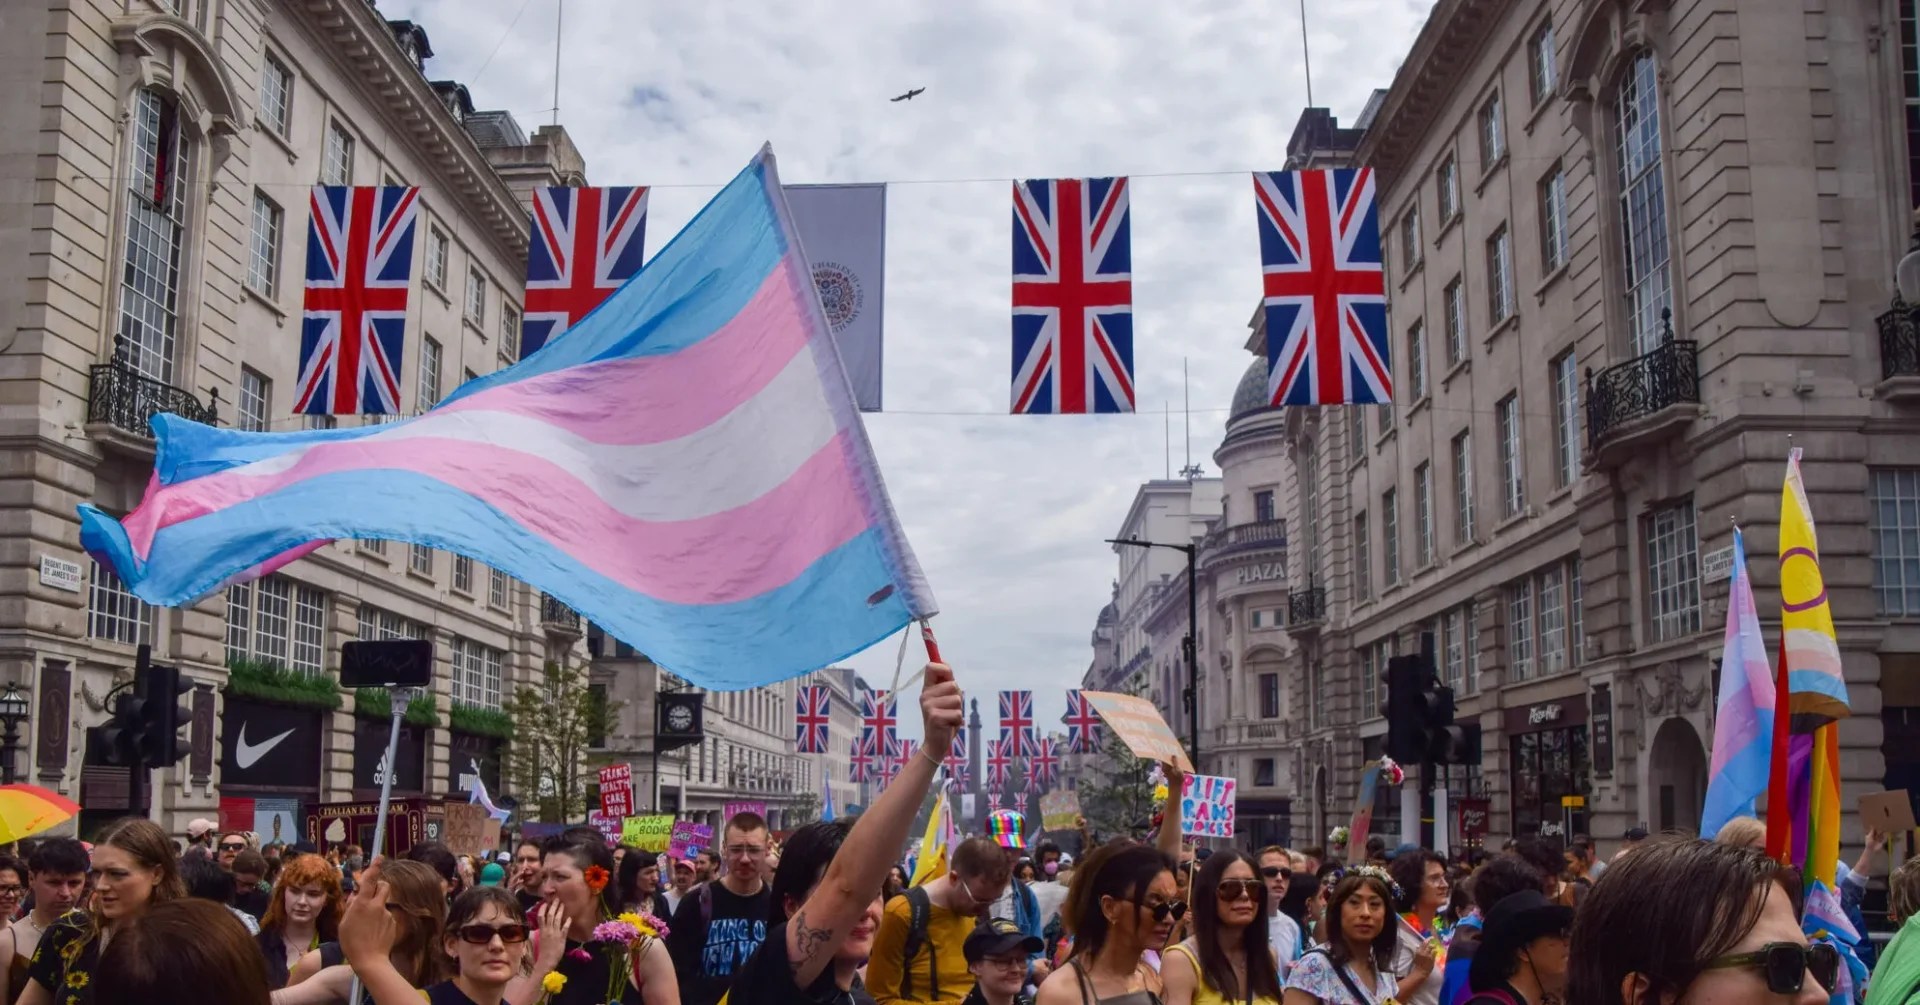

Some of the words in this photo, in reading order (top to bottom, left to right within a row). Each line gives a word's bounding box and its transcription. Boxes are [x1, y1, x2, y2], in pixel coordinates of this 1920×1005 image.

[44, 558, 62, 571] REGENT
[62, 563, 78, 574] STREET
[1236, 562, 1285, 583] PLAZA
[600, 766, 629, 781] TRANS
[600, 779, 631, 793] HEALTH
[1182, 774, 1235, 806] PLIFT
[605, 792, 626, 805] CARE
[323, 805, 357, 816] ITALIAN
[360, 805, 372, 814] ICE
[607, 804, 627, 816] NOW
[728, 803, 760, 815] TRANS
[1182, 799, 1233, 821] RANS
[628, 816, 662, 826] TRANS
[640, 824, 673, 836] BODIES
[623, 834, 638, 843] ARE
[706, 918, 749, 945] KING
